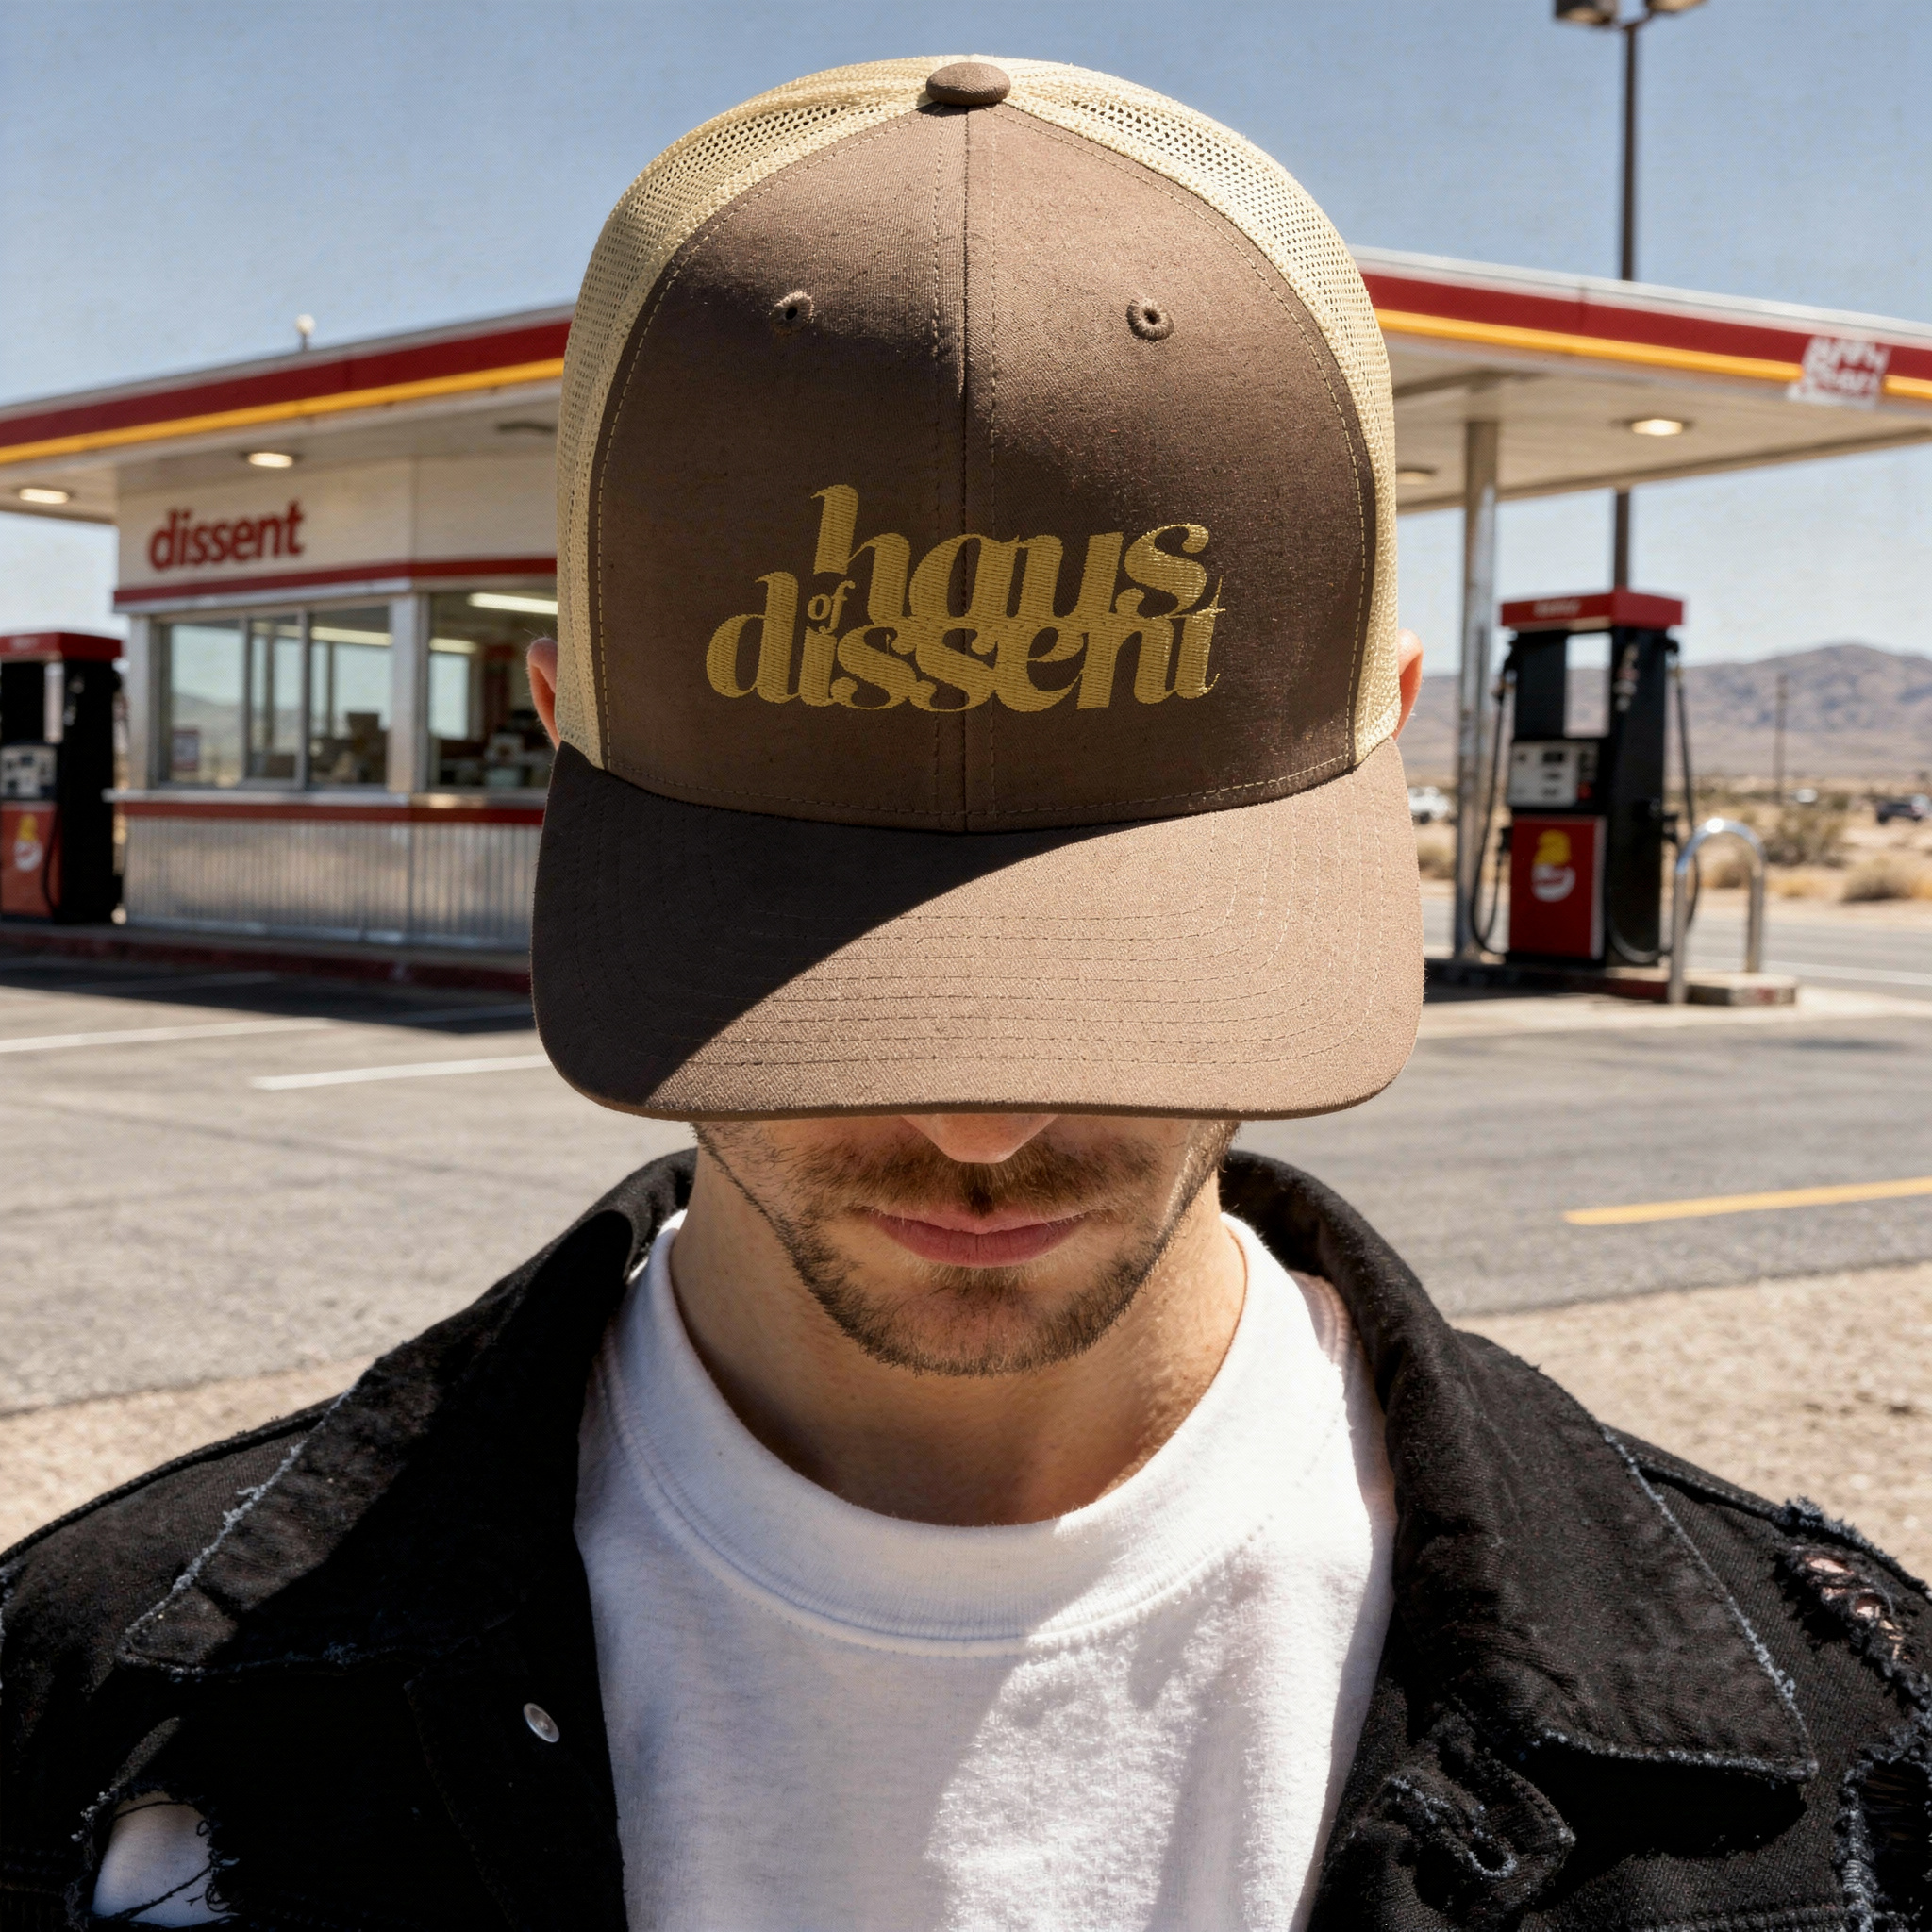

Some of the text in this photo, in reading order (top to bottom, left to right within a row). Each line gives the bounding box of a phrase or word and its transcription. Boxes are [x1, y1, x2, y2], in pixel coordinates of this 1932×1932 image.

[149, 499, 304, 571] dissent
[810, 484, 1210, 626] haus
[706, 571, 1226, 712] dissent
[808, 580, 856, 634] of
